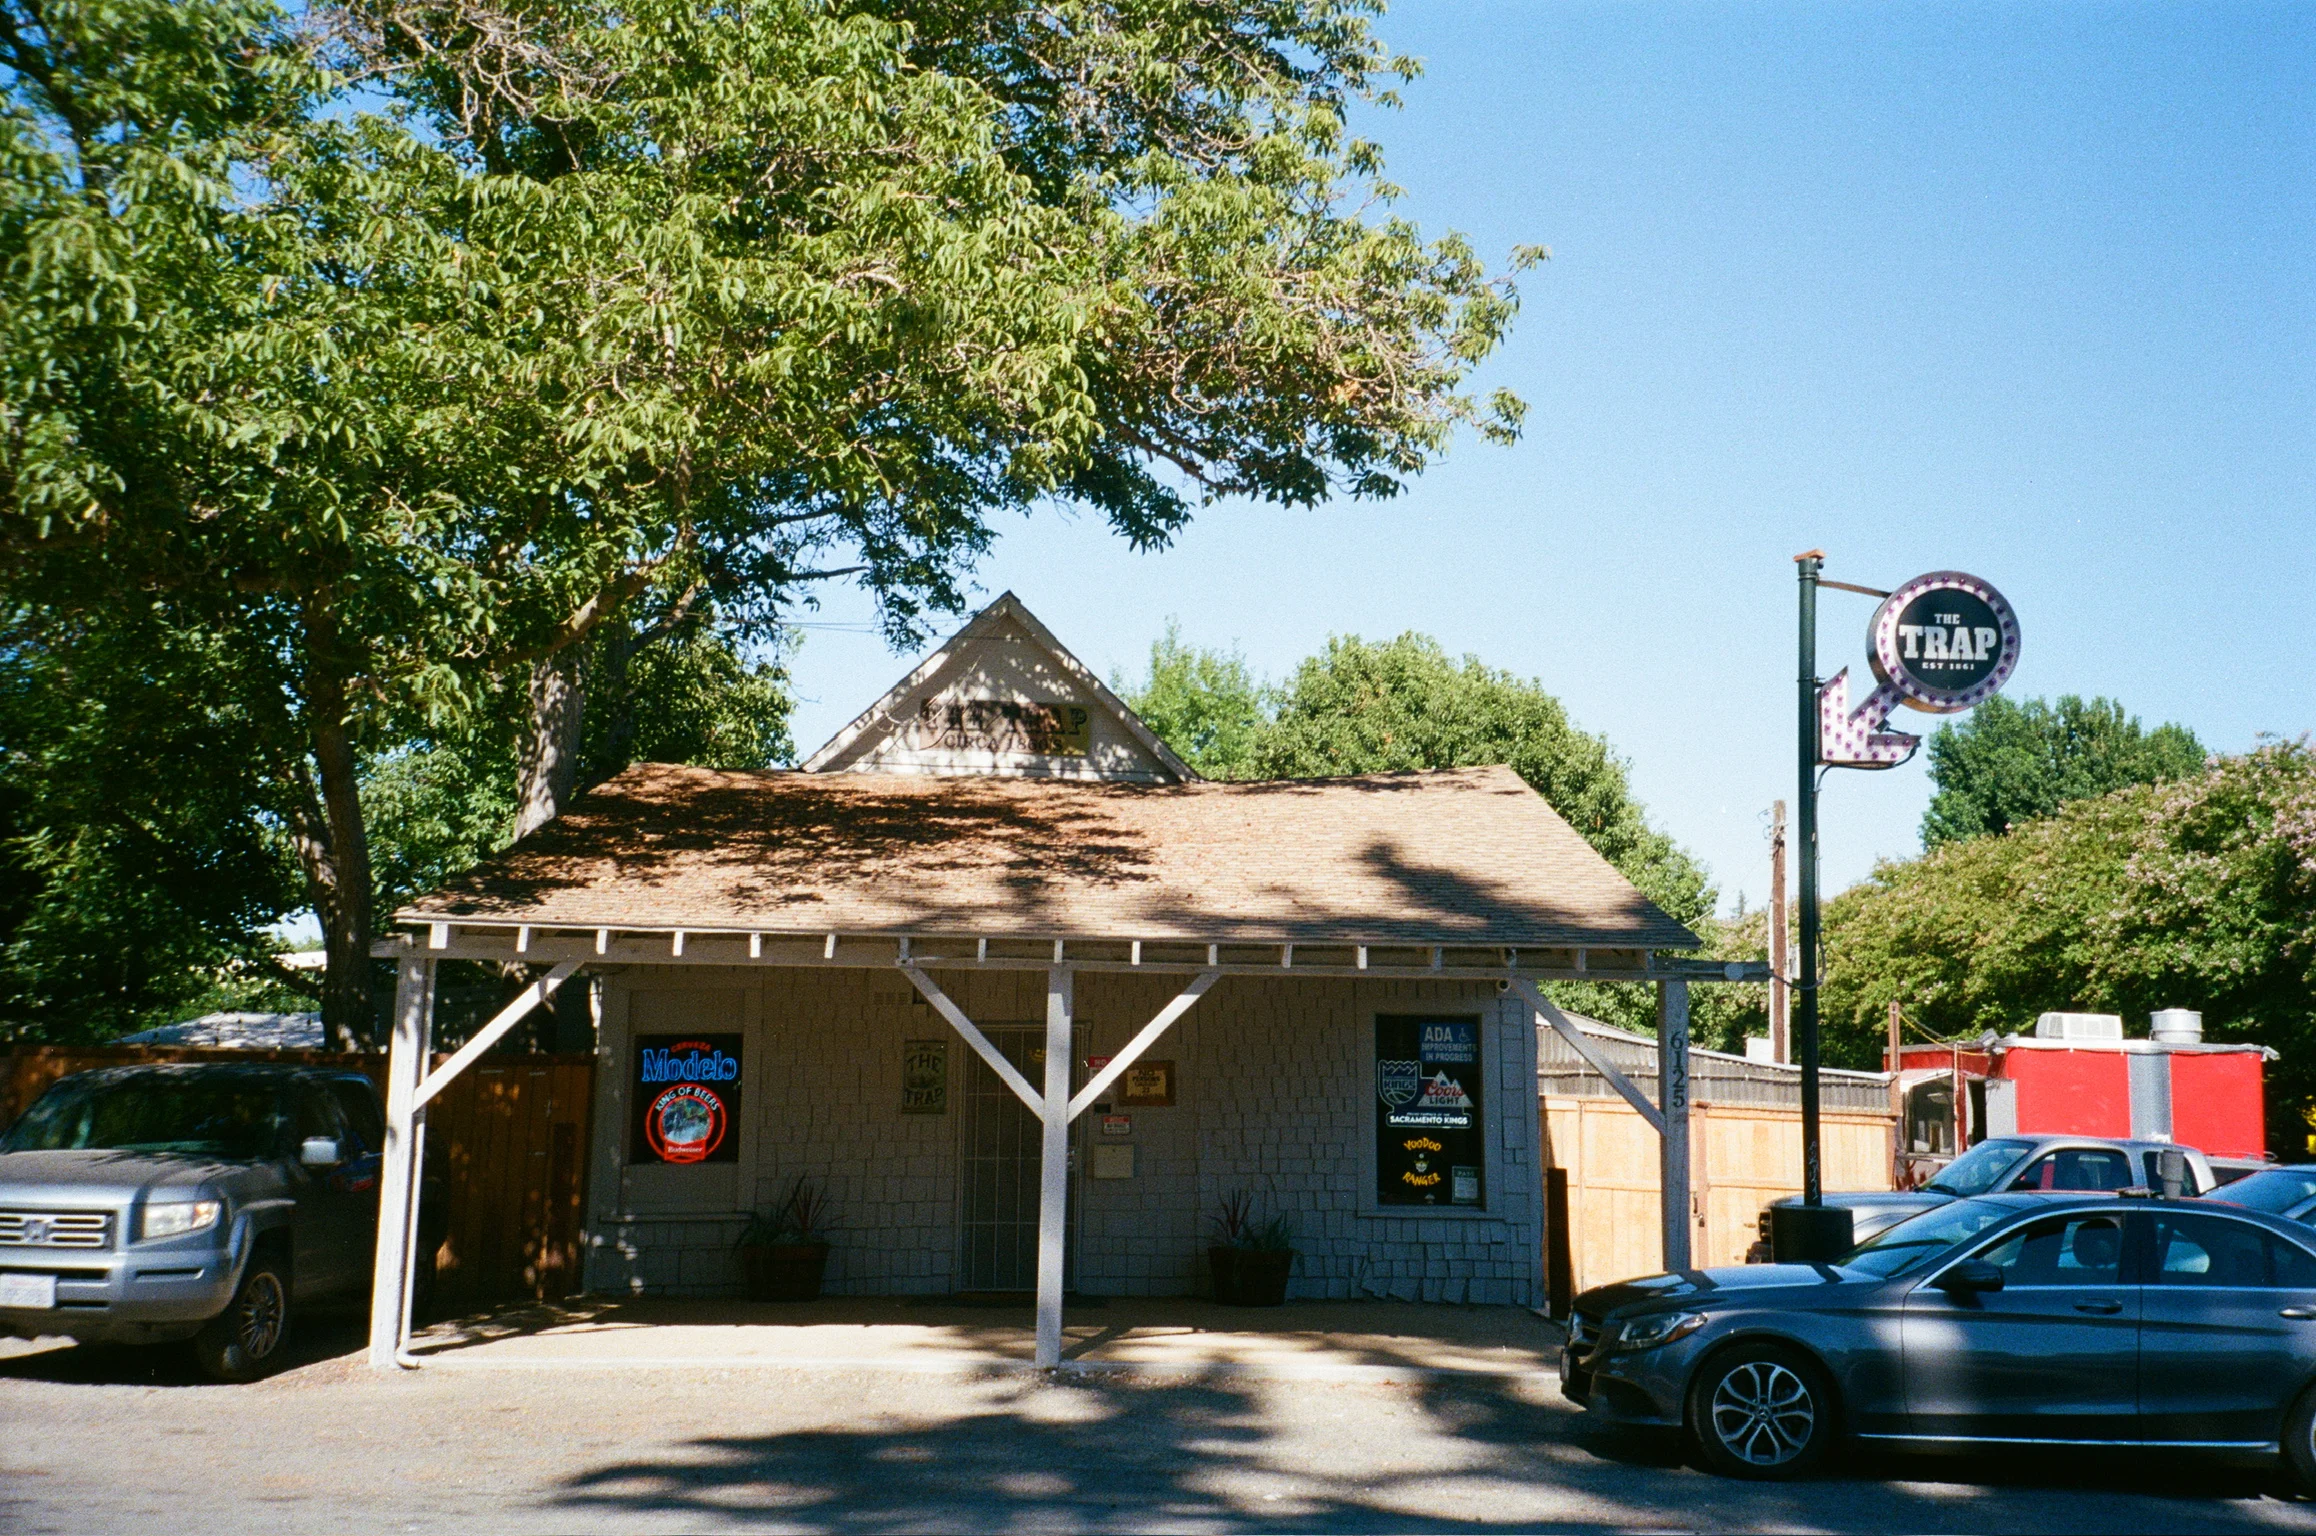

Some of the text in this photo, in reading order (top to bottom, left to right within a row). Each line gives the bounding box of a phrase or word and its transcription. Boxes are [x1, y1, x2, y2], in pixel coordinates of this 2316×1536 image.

[1934, 613, 1960, 625] THE
[1898, 624, 1998, 661] TRAP
[1921, 661, 1944, 670] EST
[1424, 1026, 1454, 1042] ADA
[670, 1041, 711, 1053] CERVEZA
[1421, 1043, 1477, 1052] IMPROVEMENTS
[641, 1048, 738, 1082] Modelo
[907, 1053, 942, 1073] THE
[1425, 1052, 1473, 1062] IN PROGRESS
[1670, 1030, 1686, 1108] 6125
[904, 1087, 944, 1106] TRAP
[1424, 1080, 1465, 1097] Coors
[654, 1086, 720, 1112] KING OF BEERS
[1429, 1096, 1460, 1105] LIGHT
[1389, 1115, 1468, 1125] SACRAMENTO KINGS
[667, 1145, 704, 1154] Budweiser
[1403, 1136, 1442, 1152] VOODOO
[1402, 1171, 1441, 1187] RANGER
